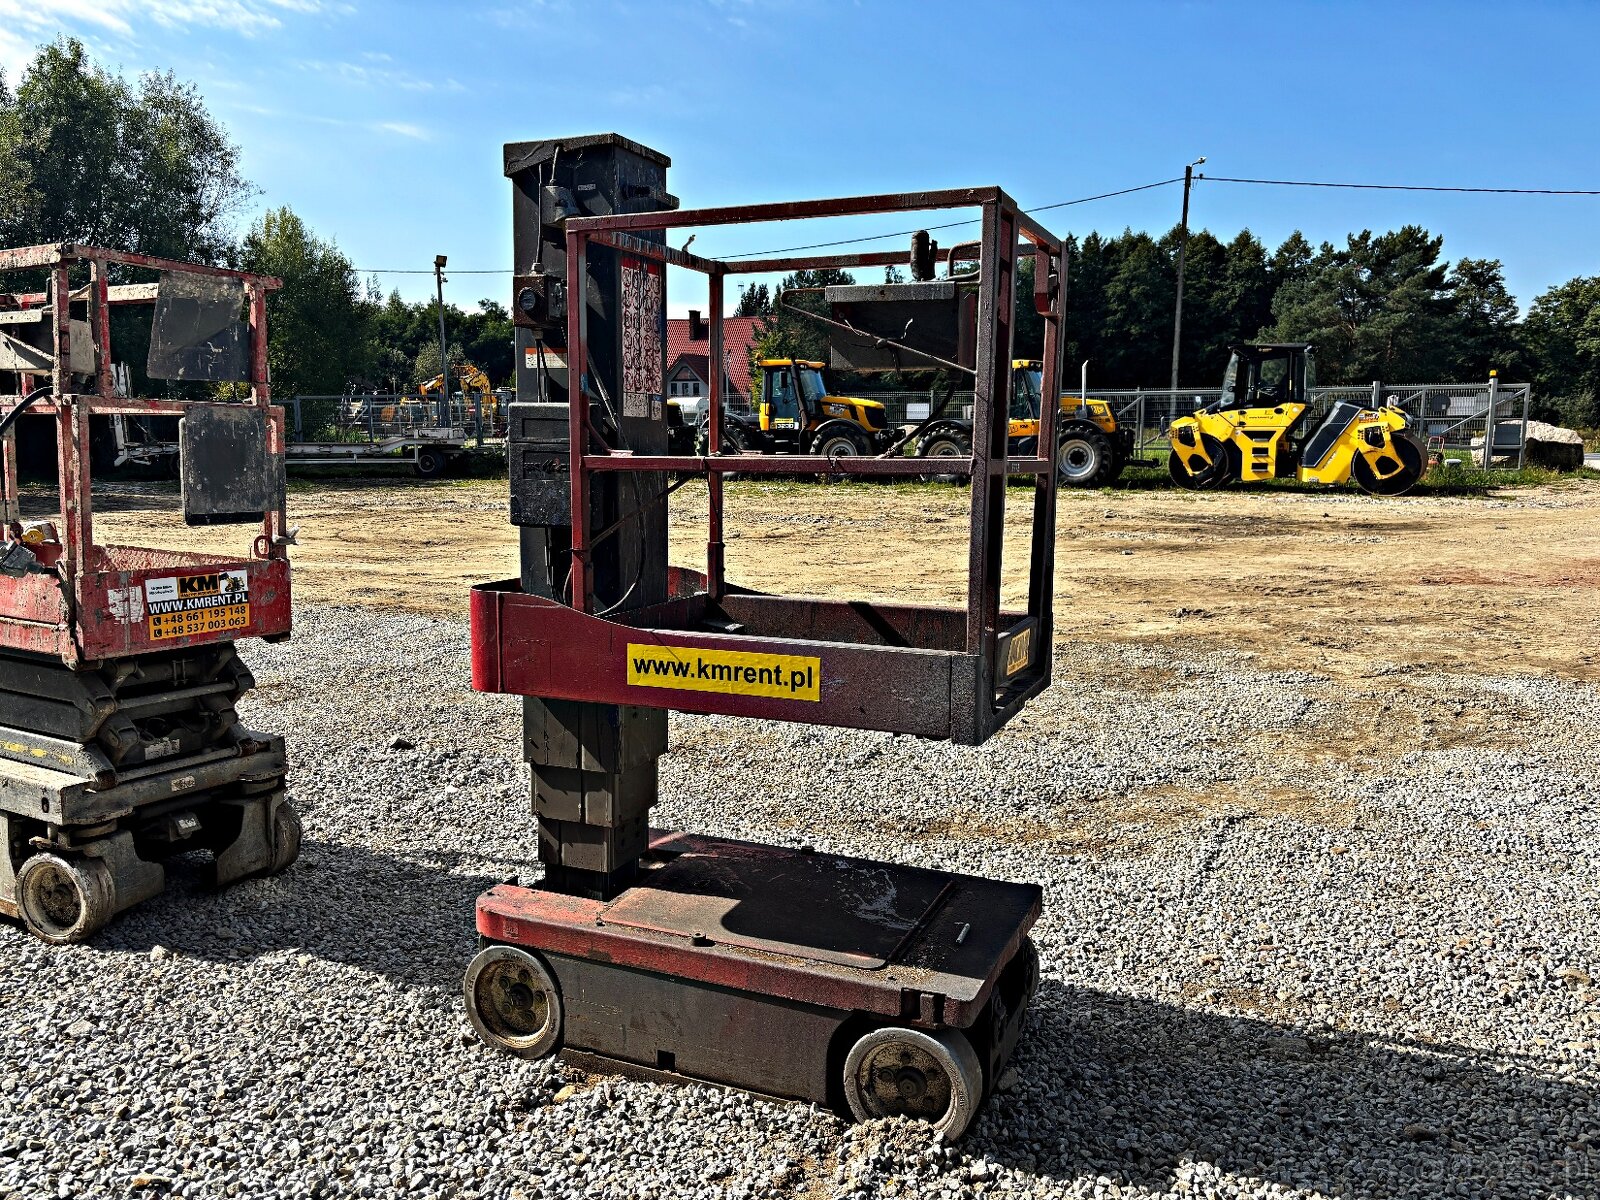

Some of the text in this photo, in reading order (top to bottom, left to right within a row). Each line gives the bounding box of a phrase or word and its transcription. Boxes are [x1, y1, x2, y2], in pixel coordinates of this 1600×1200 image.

[179, 575, 218, 593] KM
[149, 593, 248, 614] WWW.KMRENT.PL
[163, 606, 246, 625] +48 661 195 148
[164, 617, 246, 636] +48 537 003 063
[633, 657, 813, 692] www.kmrent.pl
